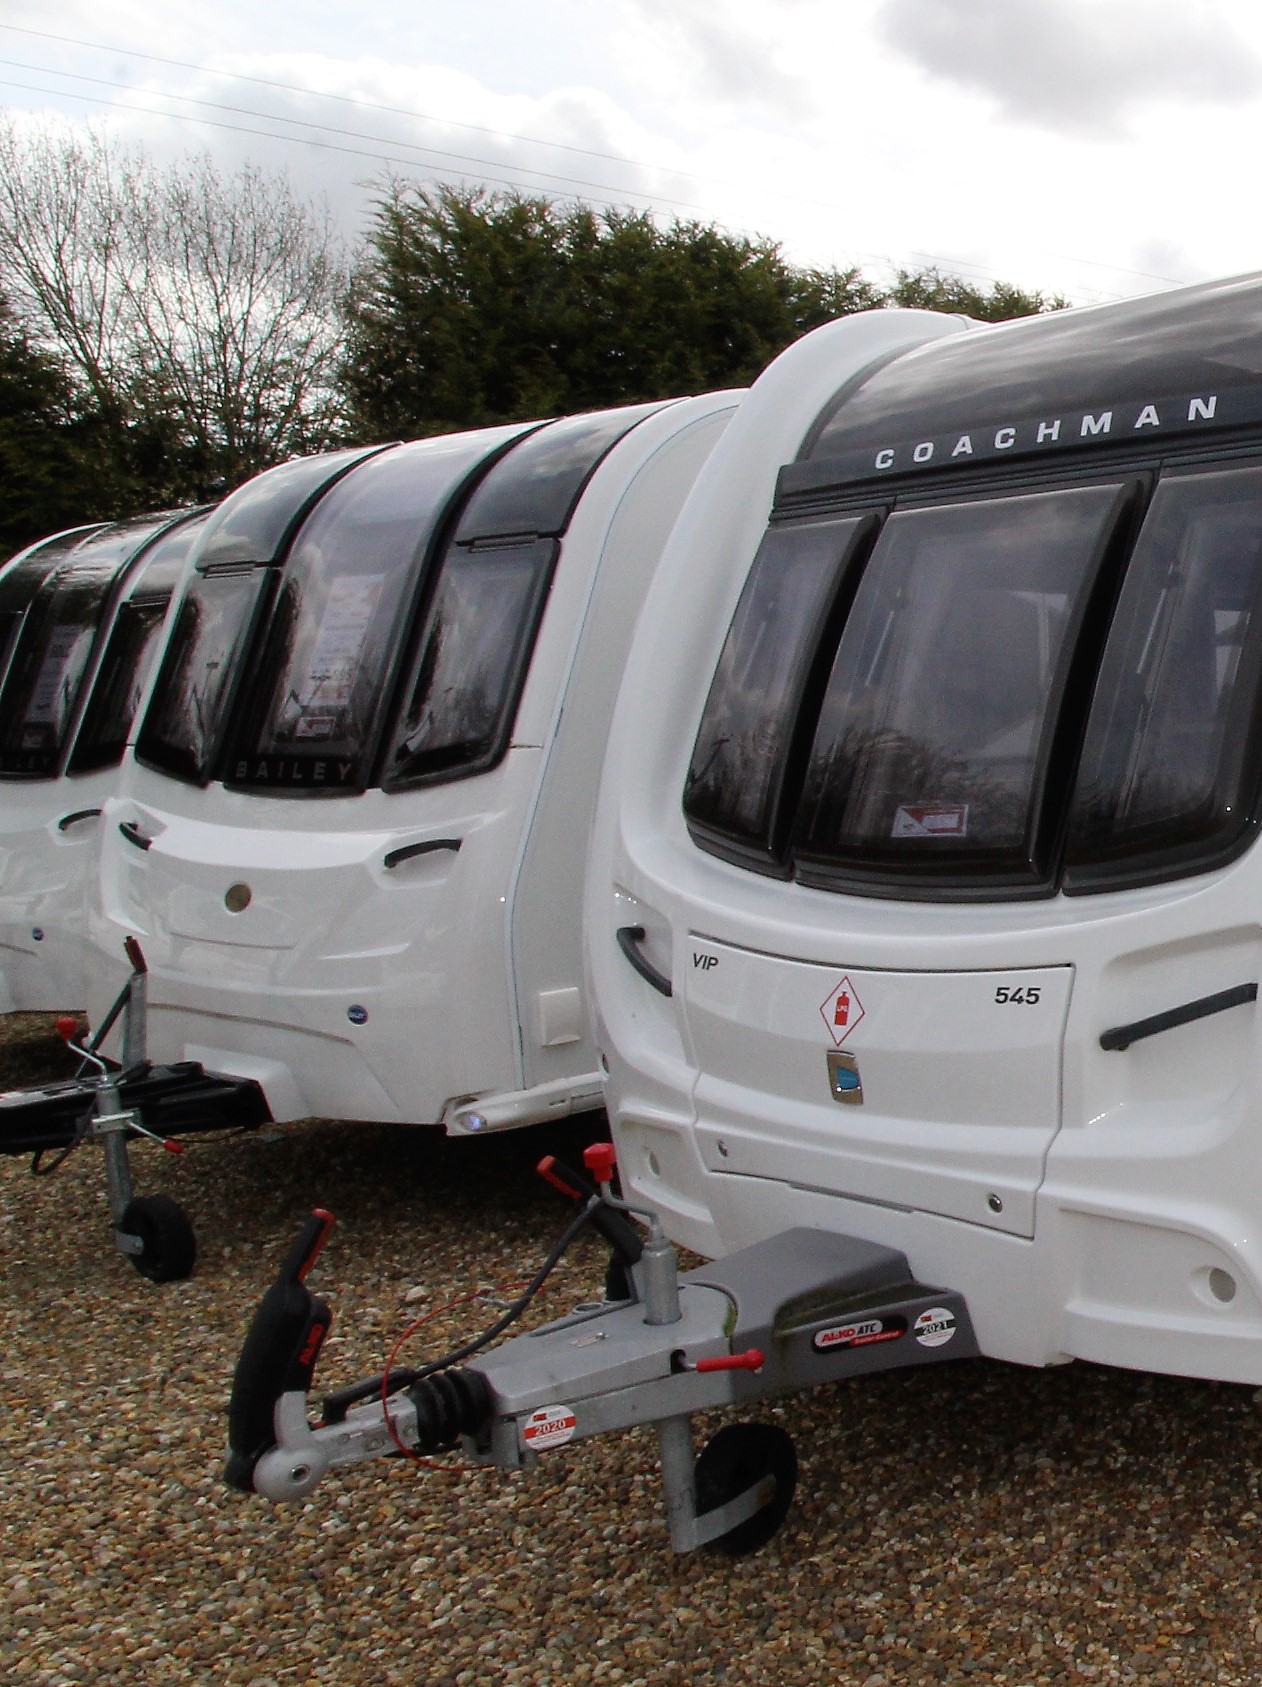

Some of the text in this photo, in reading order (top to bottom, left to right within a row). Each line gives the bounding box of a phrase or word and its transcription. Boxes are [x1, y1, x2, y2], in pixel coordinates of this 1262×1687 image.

[875, 396, 1217, 470] COACHMAN
[236, 761, 351, 779] BAILEY
[692, 952, 719, 970] VIP
[994, 987, 1041, 1005] 545
[857, 1323, 876, 1334] ATC
[922, 1321, 950, 1334] 2021
[535, 1420, 566, 1435] 2020
